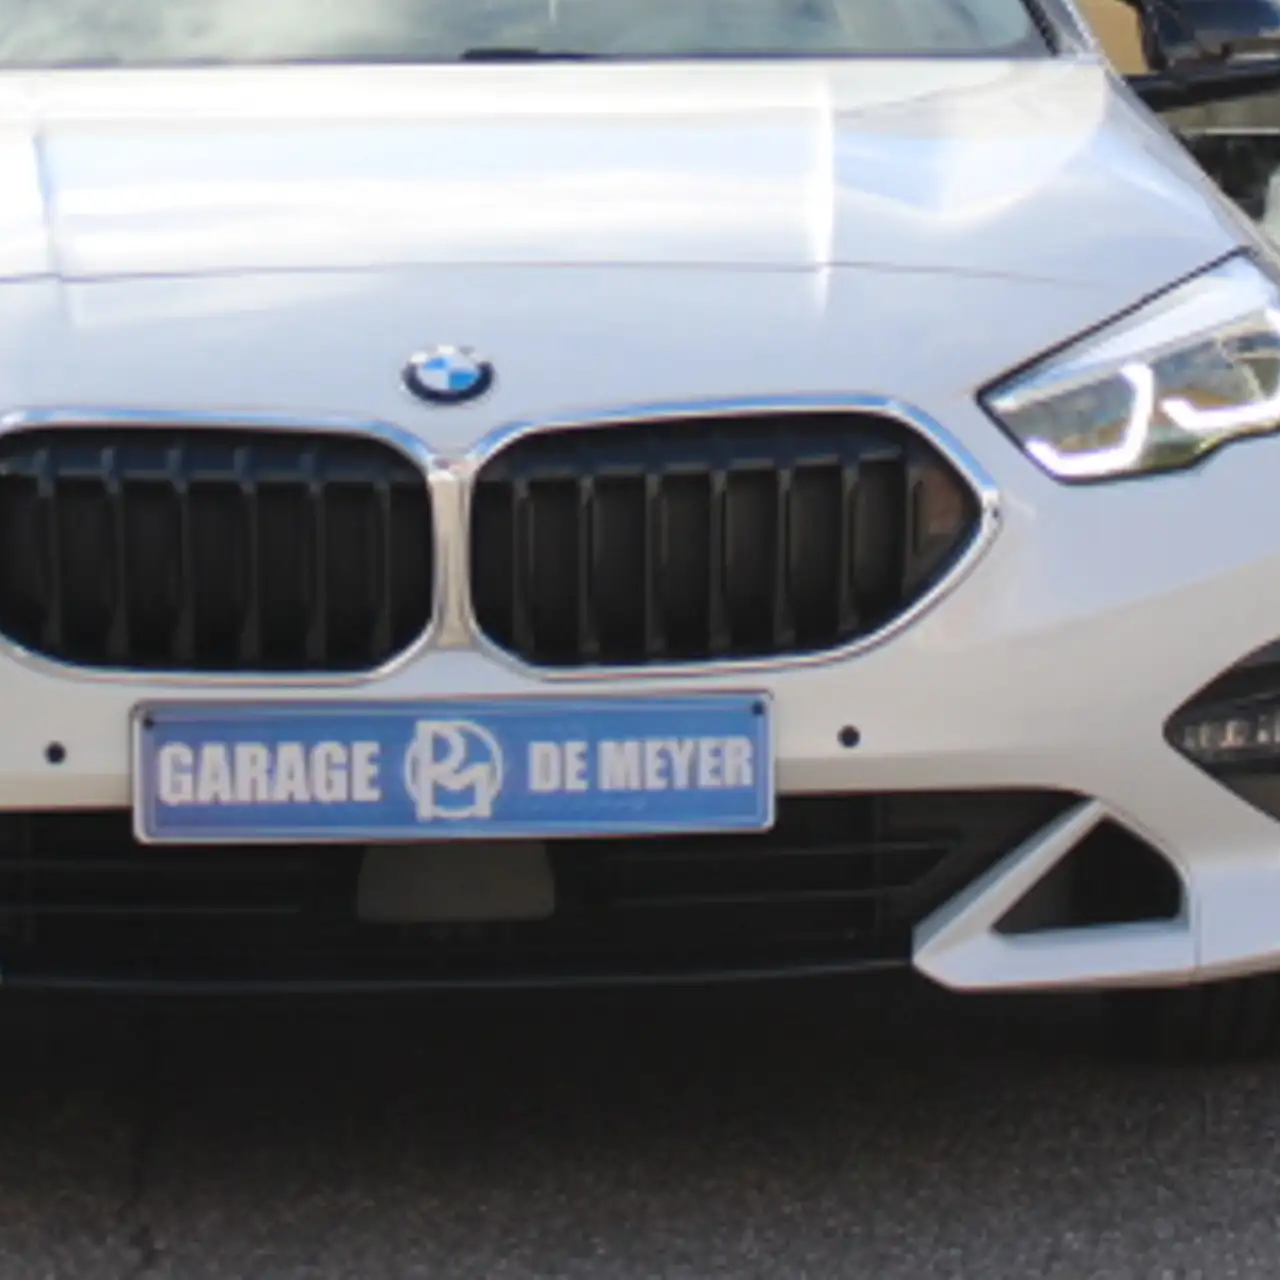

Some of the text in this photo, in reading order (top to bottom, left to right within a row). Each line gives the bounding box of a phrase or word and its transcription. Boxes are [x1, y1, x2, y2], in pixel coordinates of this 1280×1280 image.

[158, 742, 381, 805] GARAGE
[528, 740, 588, 792] DE
[598, 736, 754, 789] MEYER
